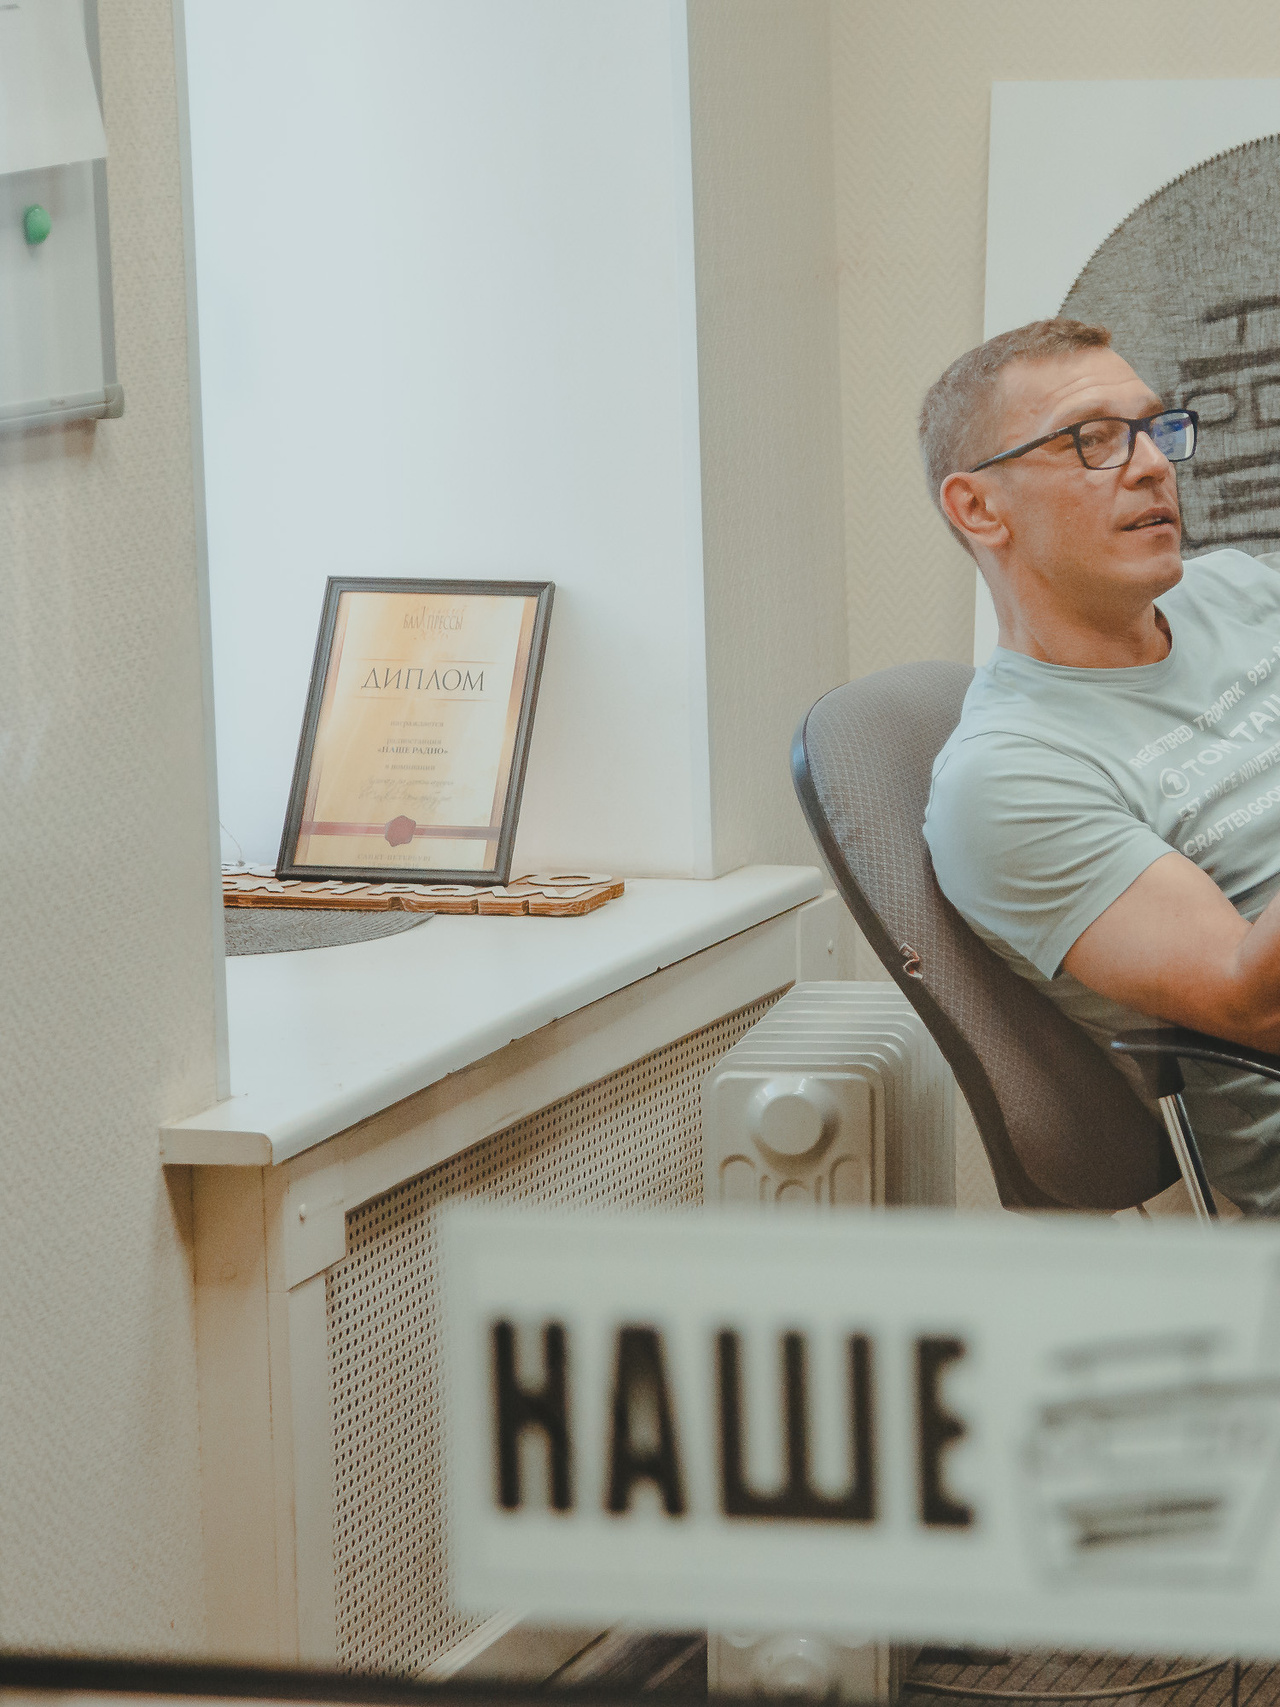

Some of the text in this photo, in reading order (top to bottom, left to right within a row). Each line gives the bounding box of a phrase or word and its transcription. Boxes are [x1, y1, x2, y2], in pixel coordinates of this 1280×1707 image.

[360, 667, 485, 692] ДИПЛОМ
[1181, 738, 1243, 777] TOM
[1183, 808, 1252, 857] CRAFTED
[488, 1316, 976, 1531] НАШЕ
